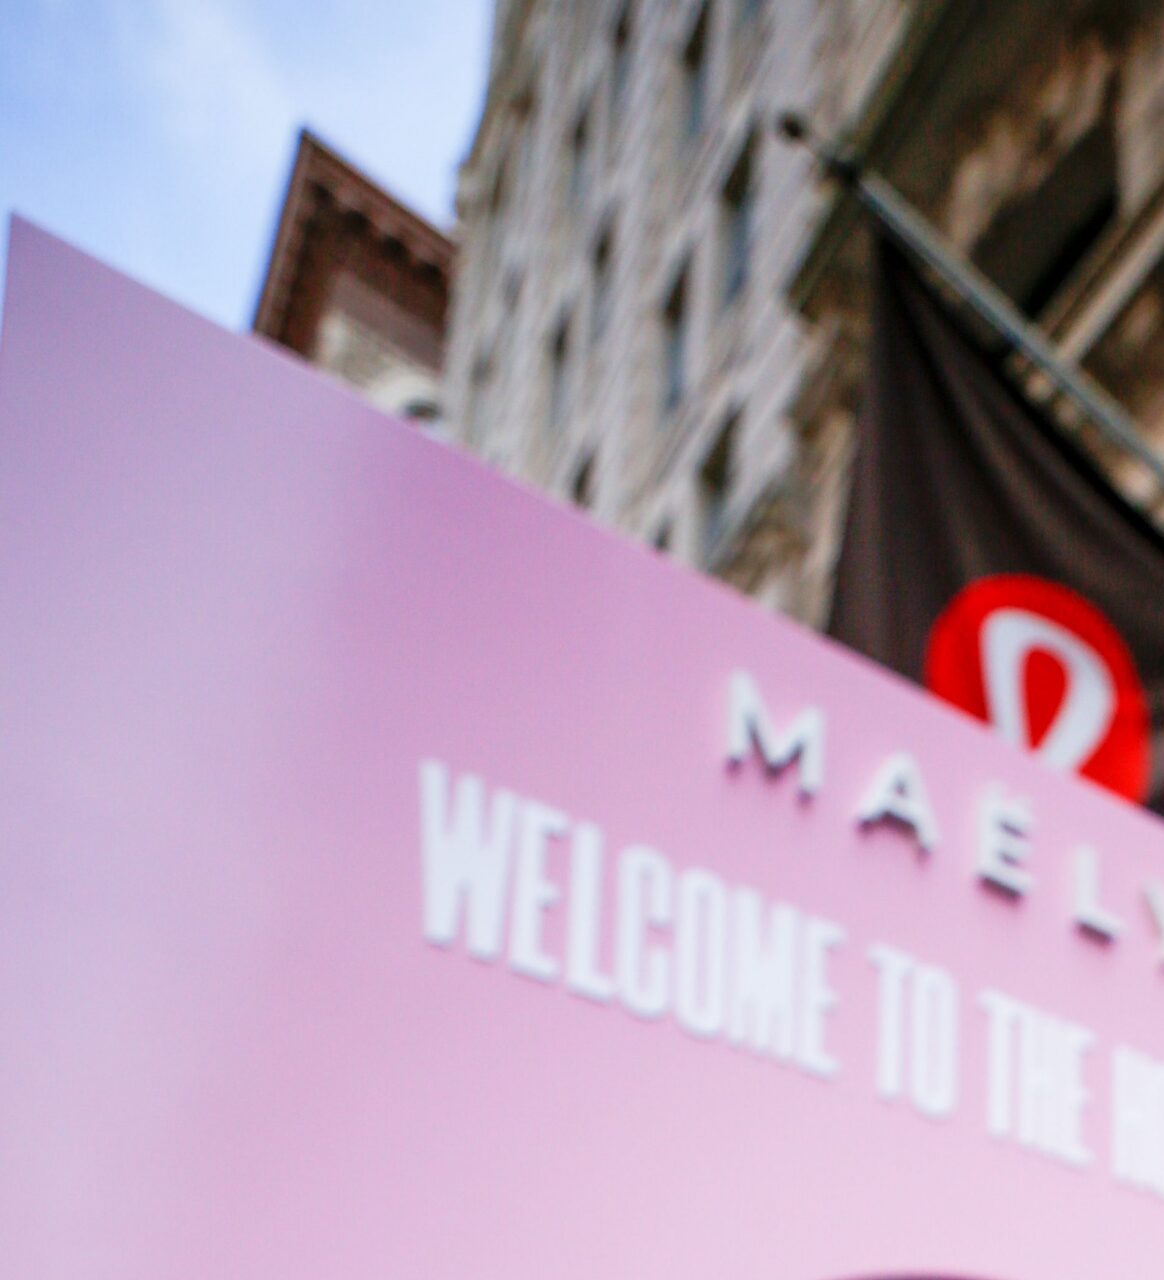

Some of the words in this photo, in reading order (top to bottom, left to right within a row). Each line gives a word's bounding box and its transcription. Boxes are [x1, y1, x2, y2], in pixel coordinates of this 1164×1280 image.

[418, 758, 845, 1080] WELCOME
[867, 943, 960, 1121] TO
[976, 985, 1097, 1170] THE
